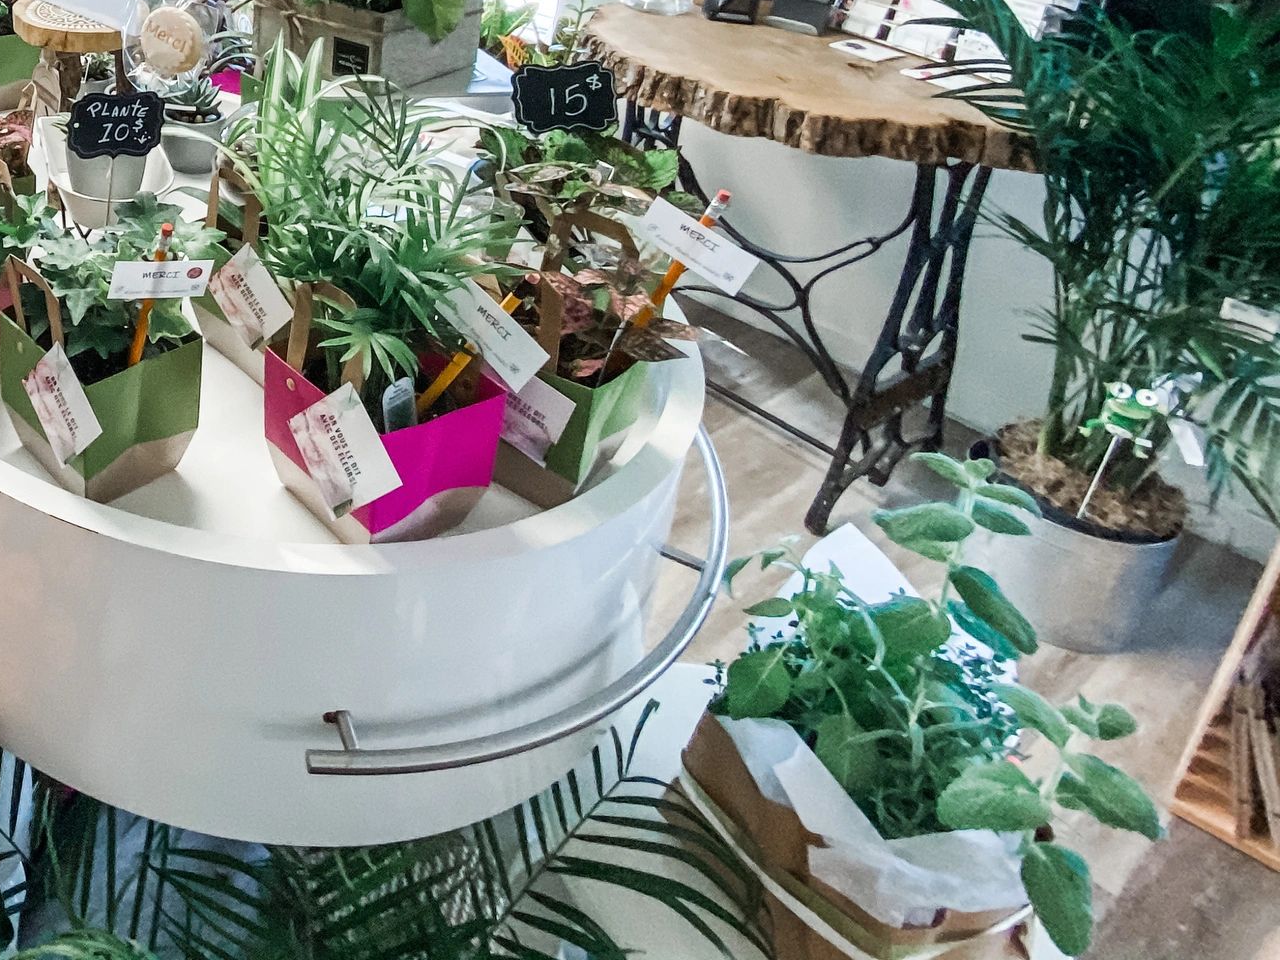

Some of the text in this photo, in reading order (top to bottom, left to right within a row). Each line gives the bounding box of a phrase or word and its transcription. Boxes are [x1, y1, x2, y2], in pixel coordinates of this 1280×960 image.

[679, 223, 721, 253] MERCI
[142, 270, 181, 279] MERCI
[476, 305, 513, 342] MERCI
[320, 413, 332, 434] AVEC
[329, 435, 339, 451] DES
[334, 427, 348, 449] VOUS
[345, 450, 354, 460] LE
[350, 462, 361, 475] DIT
